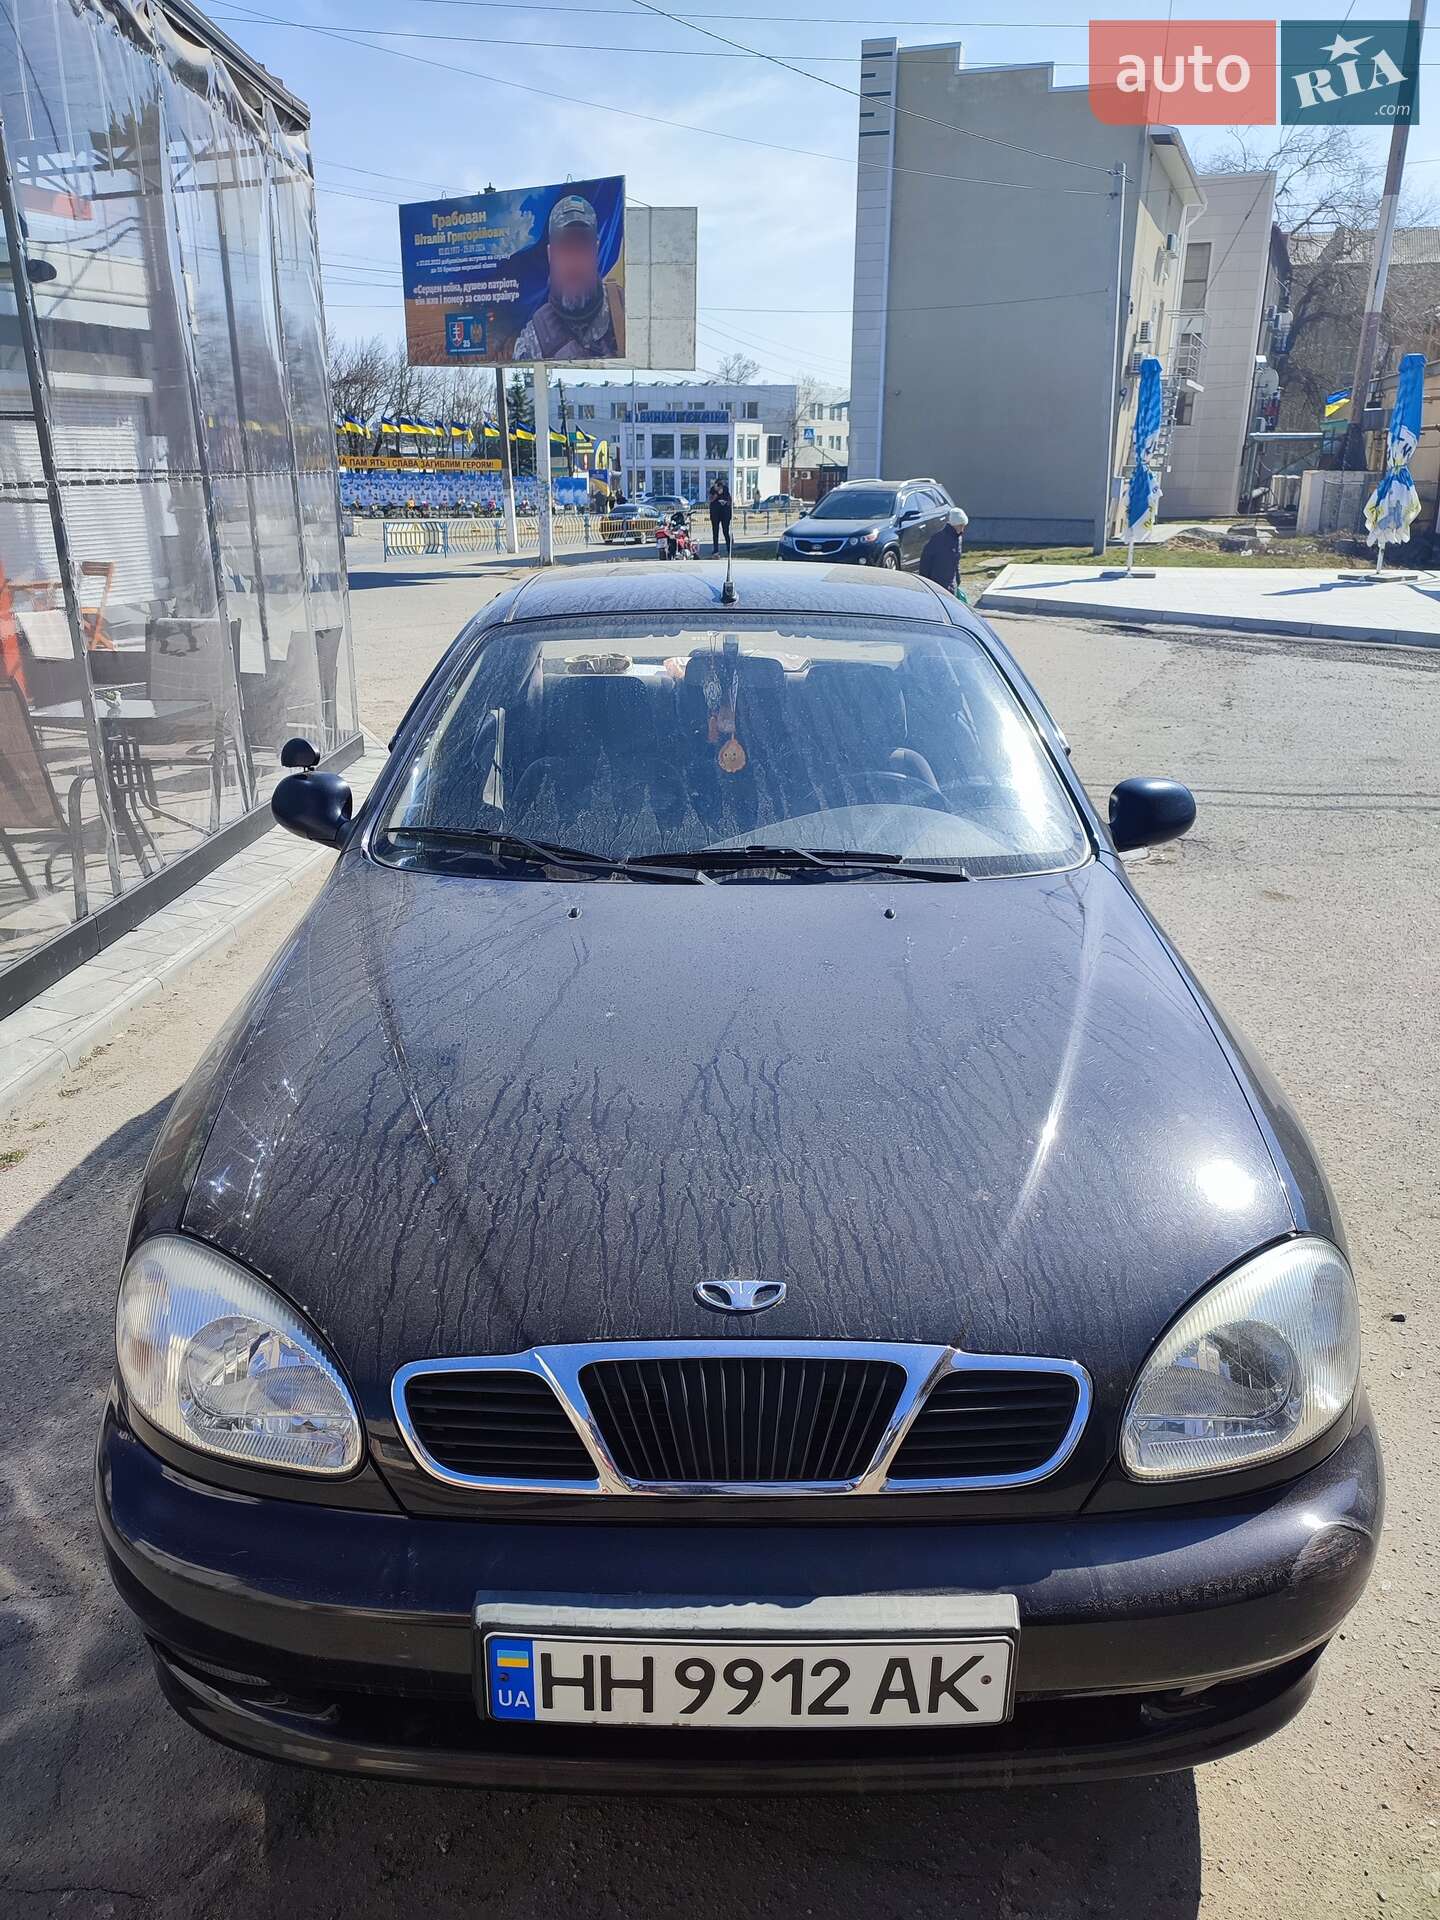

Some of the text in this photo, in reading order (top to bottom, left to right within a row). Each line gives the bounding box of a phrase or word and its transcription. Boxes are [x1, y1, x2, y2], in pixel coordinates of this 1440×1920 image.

[431, 210, 487, 231] Грабован
[391, 458, 418, 468] СЛАВА
[420, 459, 461, 468] ЗАГИБЛИМ
[462, 460, 494, 469] ГЕРОЯМ!
[498, 1651, 986, 1716] UA HH 9912 AK
